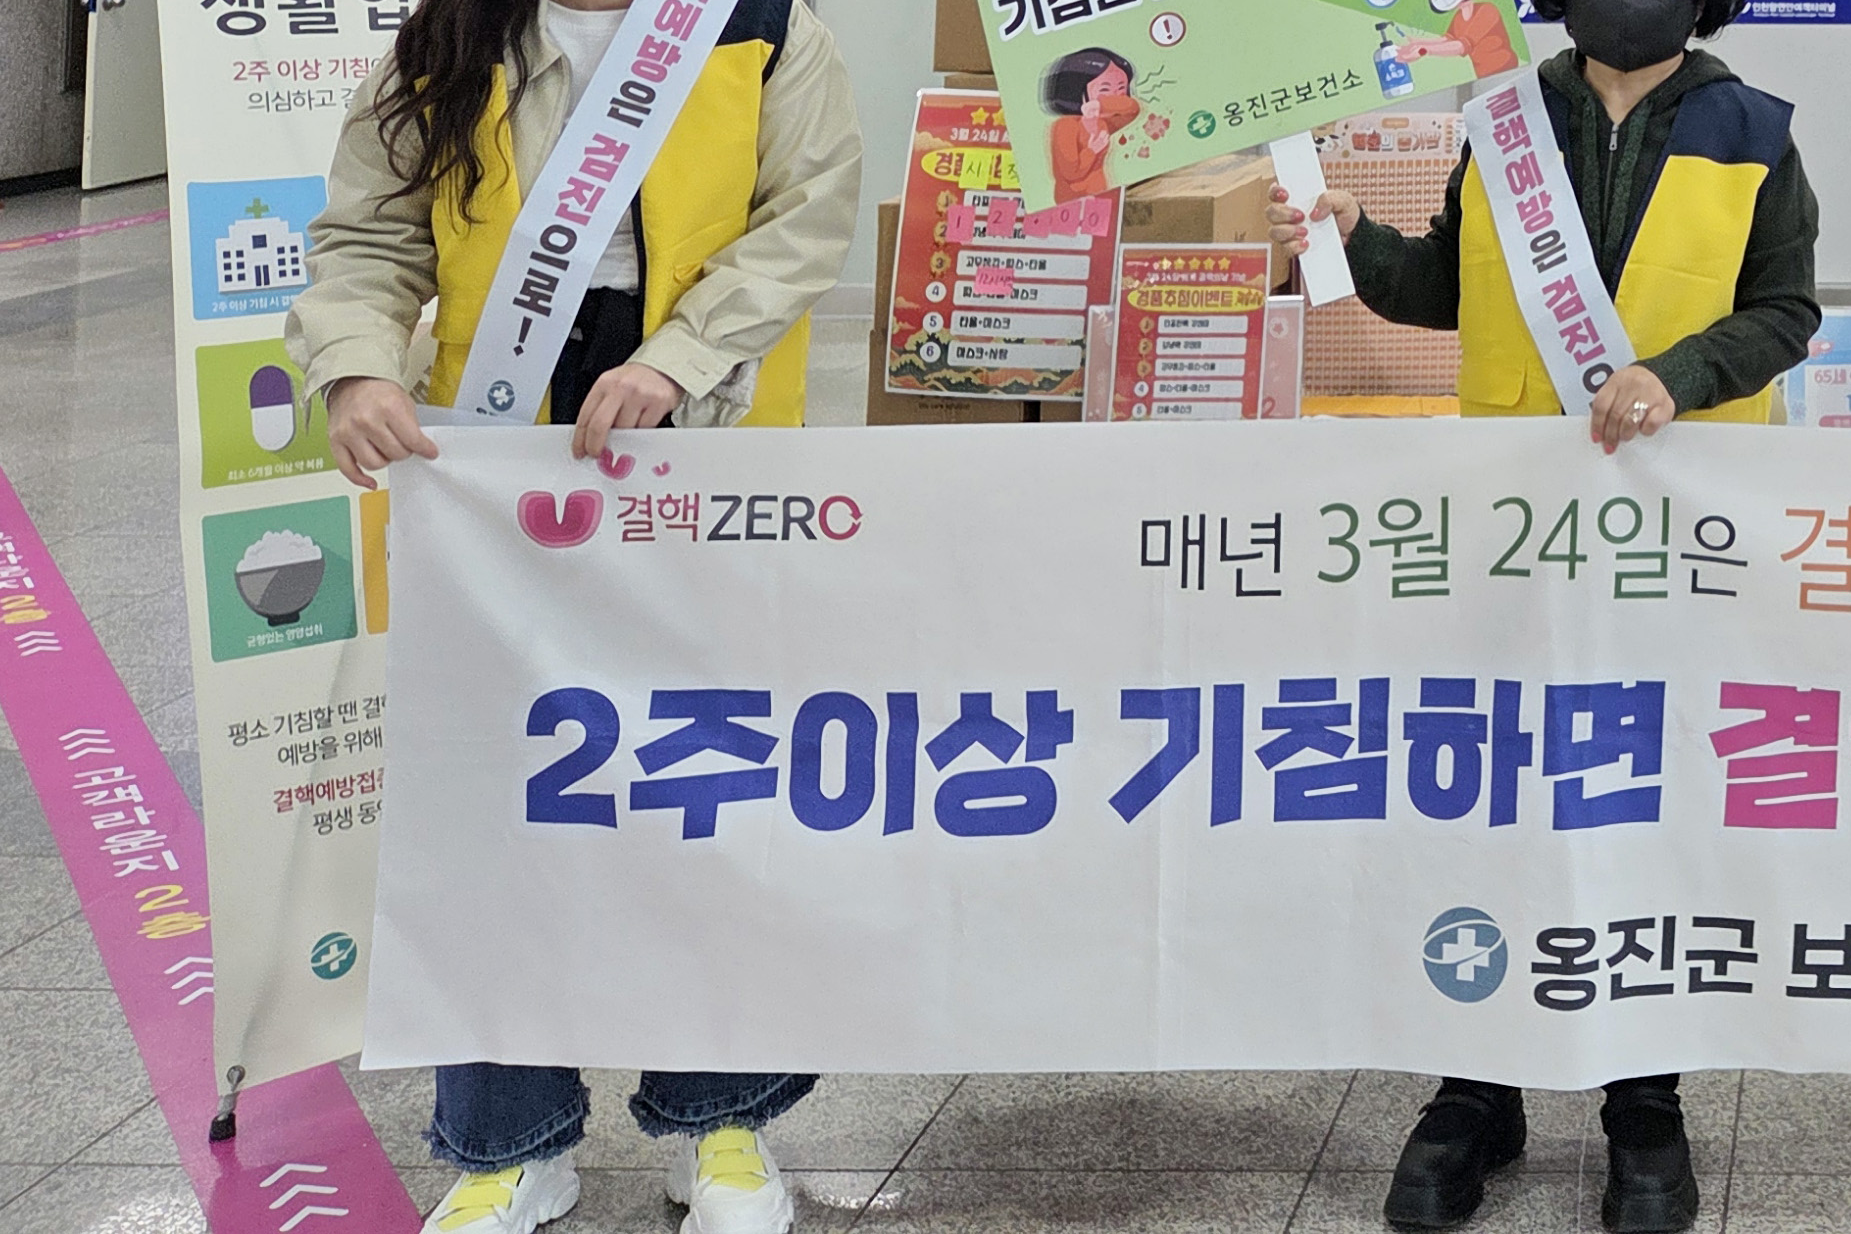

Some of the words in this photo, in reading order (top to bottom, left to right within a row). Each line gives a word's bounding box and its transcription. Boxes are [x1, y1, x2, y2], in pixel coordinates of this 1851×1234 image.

[233, 61, 271, 83] 2주
[277, 58, 321, 81] 이상
[247, 88, 337, 114] 의심하고
[1222, 67, 1365, 127] 옹진군보건소
[1484, 85, 1568, 274] 결핵예방은
[512, 132, 630, 358] 검진으로!
[929, 315, 938, 327] 5
[926, 345, 935, 357] 6
[615, 492, 864, 545] 결핵ZERO
[1139, 511, 1286, 598] 매년
[1315, 495, 1453, 599] 3월
[1488, 495, 1749, 600] 24일은
[228, 717, 270, 748] 평소
[274, 704, 334, 736] 기침할
[337, 699, 359, 725] 땐
[277, 734, 339, 767] 예방을
[343, 726, 383, 755] 위해
[525, 684, 1075, 842] 2주이상
[1107, 676, 1667, 831] 기침하면
[312, 807, 354, 836] 평생
[1529, 914, 1759, 1011] 옹진군
